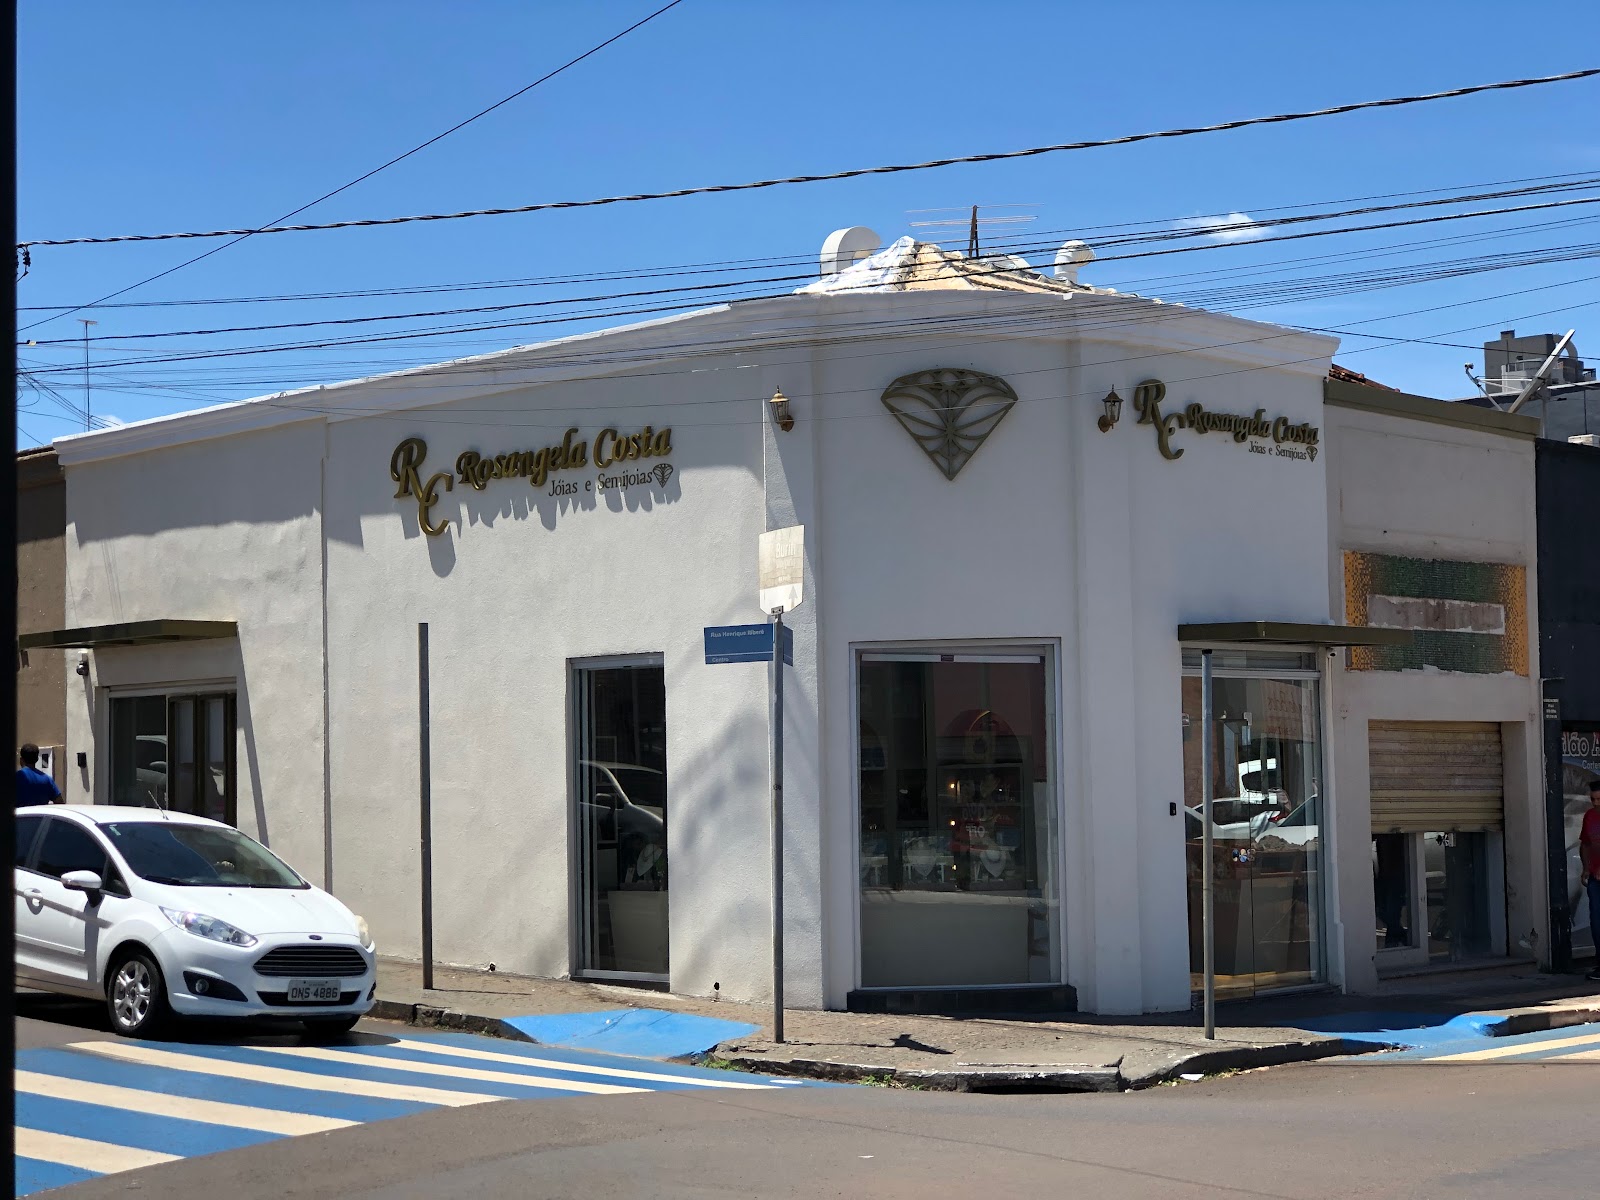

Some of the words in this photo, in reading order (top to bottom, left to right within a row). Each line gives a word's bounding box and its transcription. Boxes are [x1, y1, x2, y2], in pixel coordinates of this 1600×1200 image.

[1187, 403, 1273, 443] Rosangela
[1273, 416, 1319, 445] Costa
[456, 428, 587, 490] Rosangela
[593, 425, 673, 468] Costa
[548, 478, 578, 497] Jóias
[585, 480, 592, 492] e
[597, 468, 653, 491] Semijoias
